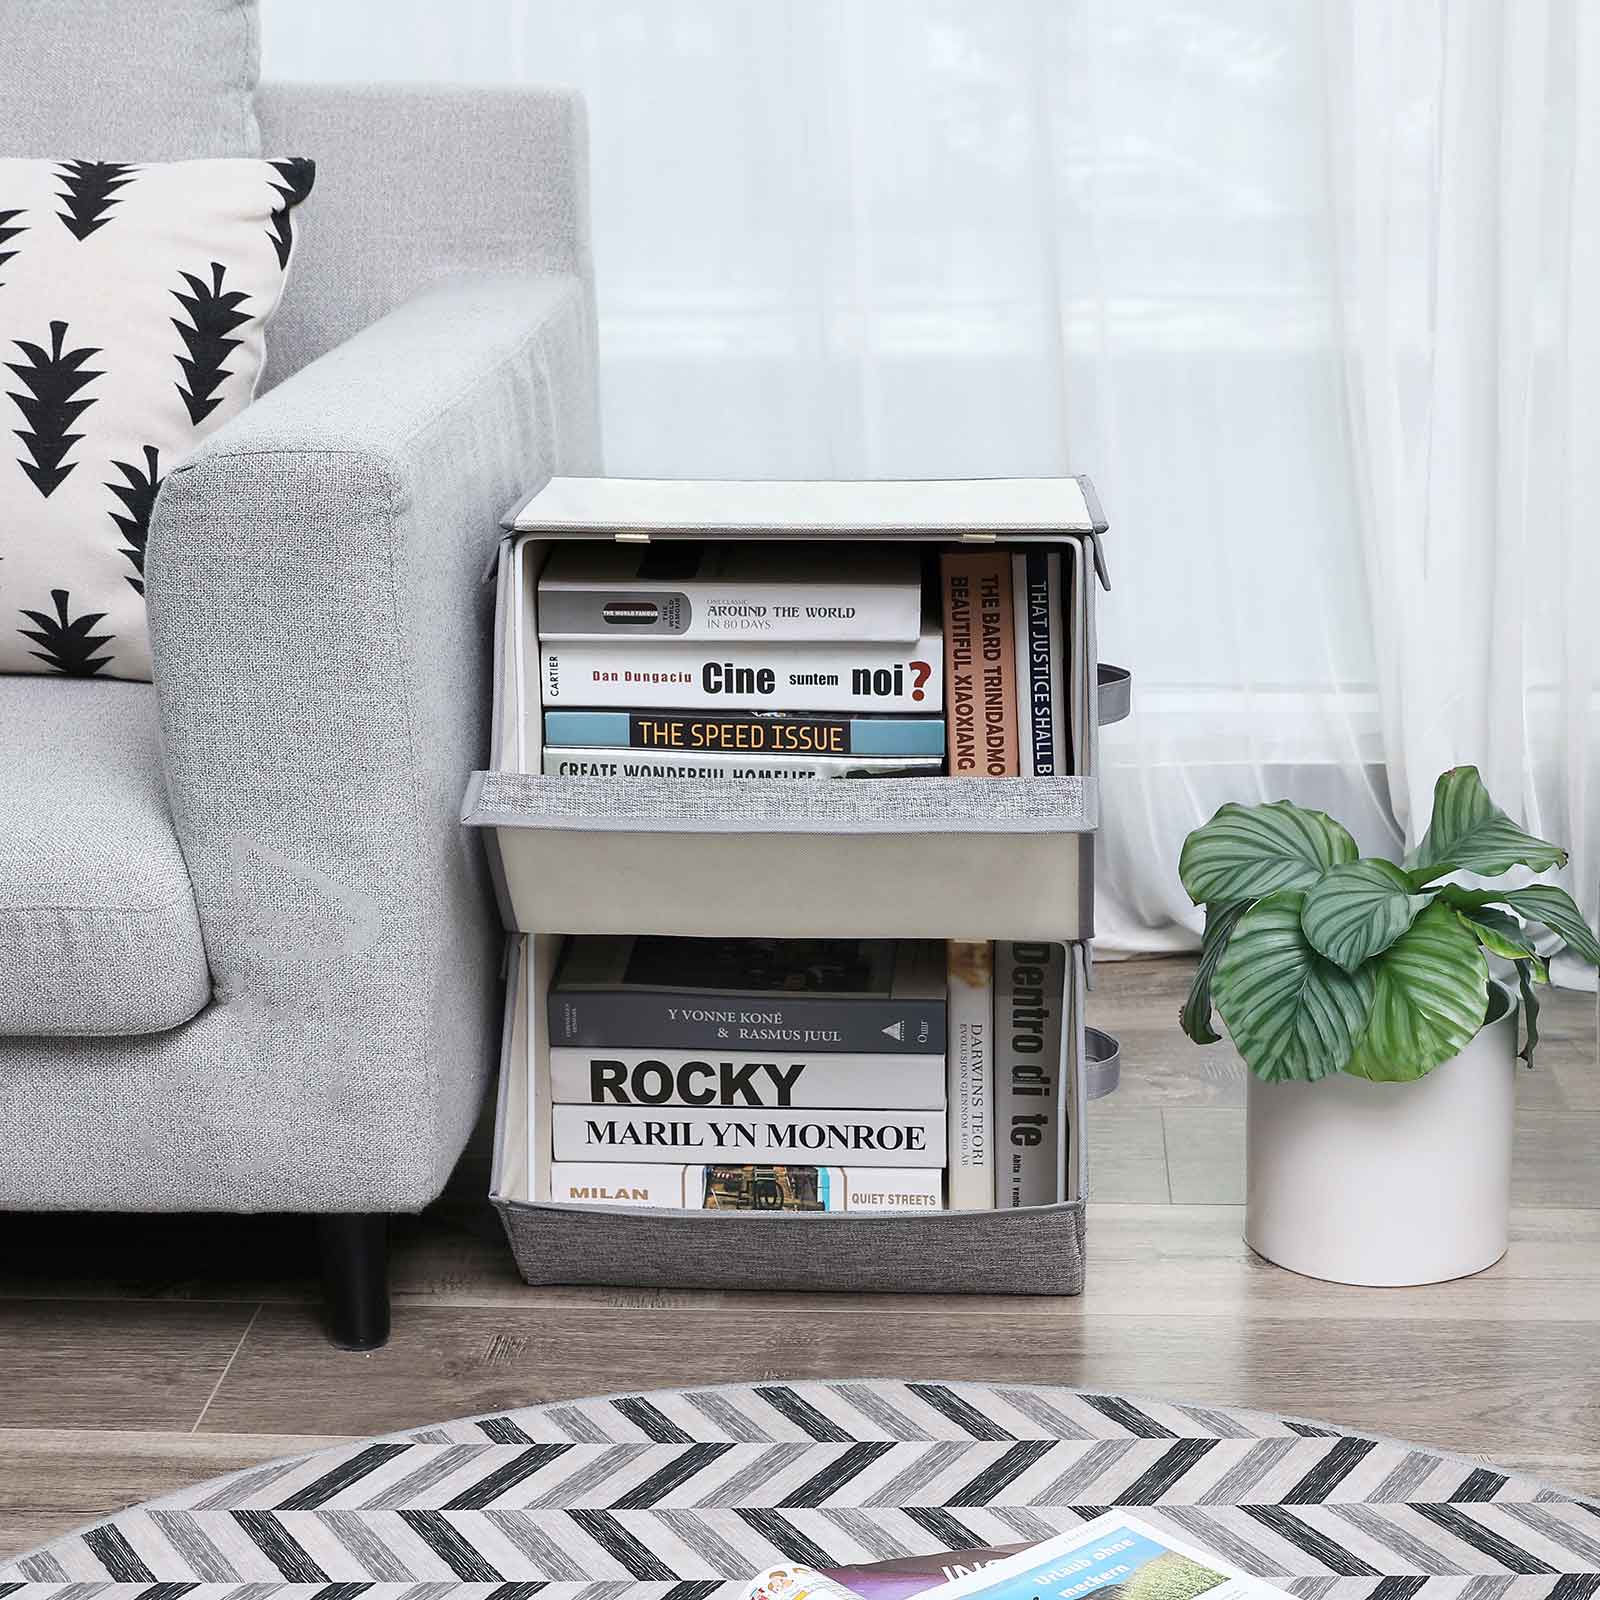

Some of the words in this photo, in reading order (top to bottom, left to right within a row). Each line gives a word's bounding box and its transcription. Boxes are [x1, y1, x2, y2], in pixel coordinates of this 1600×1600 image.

[707, 605, 767, 617] AROUND
[774, 606, 800, 618] THE
[805, 607, 856, 619] WORLD
[981, 574, 1000, 608] THE
[1031, 580, 1048, 627] THAT
[707, 619, 720, 629] IN
[724, 619, 737, 629] 80
[741, 619, 771, 630] DAYS
[951, 576, 972, 670] BEAUTIFUL
[982, 613, 1001, 661] BARD
[550, 655, 559, 697] CARTIER
[593, 670, 618, 682] Dan
[624, 671, 692, 684] Dungaciu
[702, 661, 776, 695] Cine
[789, 672, 839, 686] suntem
[1032, 631, 1050, 702] JUSTICE
[638, 721, 684, 746] THE
[691, 722, 764, 748] SPEED
[772, 725, 844, 751] ISSUE
[954, 674, 976, 770] XIAOXIANG
[983, 665, 1006, 777] TRINIDADMO
[1034, 706, 1051, 759] SHALL
[1011, 942, 1050, 1054] Dentro
[718, 1027, 729, 1038] &
[740, 1028, 800, 1041] RASMUS
[803, 1030, 841, 1042] JUUL
[959, 1023, 968, 1079] EVOLUSJON
[590, 1060, 805, 1106] ROCKY
[971, 1023, 984, 1107] DARWINS
[1011, 1064, 1050, 1097] di
[960, 1081, 969, 1129] GJENNOM
[766, 1123, 926, 1151] MONROE
[972, 1112, 984, 1167] TEORI
[1010, 1113, 1048, 1147] te
[570, 1187, 649, 1200] MILAN
[851, 1192, 885, 1206] QUIET
[888, 1193, 936, 1206] STREETS
[1033, 1556, 1093, 1586] Urlaub
[1092, 1537, 1135, 1561] ohne
